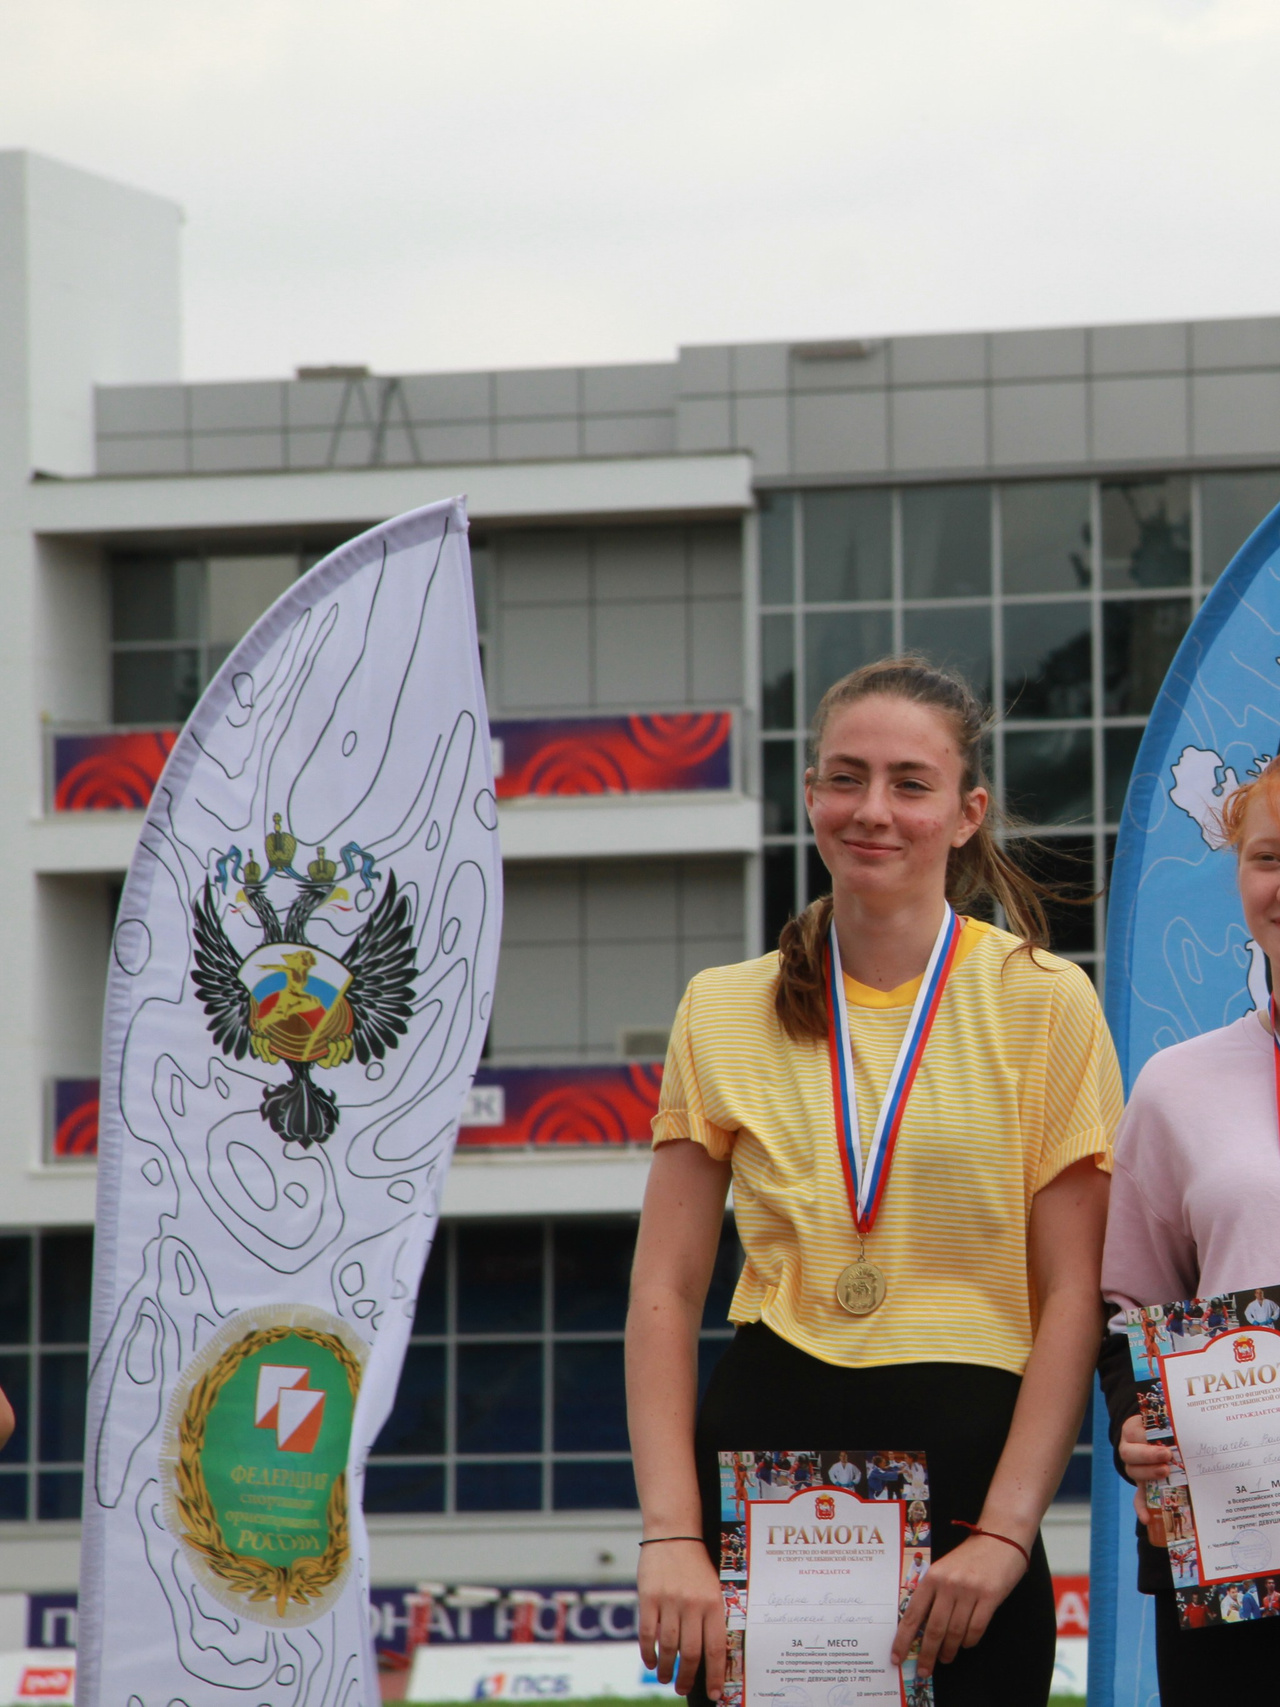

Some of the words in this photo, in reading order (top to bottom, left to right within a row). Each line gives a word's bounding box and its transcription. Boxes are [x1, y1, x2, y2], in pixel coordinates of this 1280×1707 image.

[1187, 1394, 1235, 1408] МИНИСТЕРСТВО
[1206, 1403, 1229, 1412] СПОРТУ
[1230, 1394, 1275, 1407] ЧЕЛЯБИНСКОЙ
[1226, 1407, 1280, 1422] НАГРАЖДАЕТСЯ
[1235, 1485, 1247, 1494] ЗА
[1232, 1493, 1274, 1504] Всероссийских
[1234, 1503, 1271, 1513] спортивному
[1221, 1513, 1257, 1524] дисциплине:
[1237, 1521, 1257, 1530] группе:
[766, 1525, 885, 1545] ГРАМОТА
[820, 1548, 857, 1556] ФИЗИЧЕСКОЙ
[827, 1640, 859, 1648] МЕСТО
